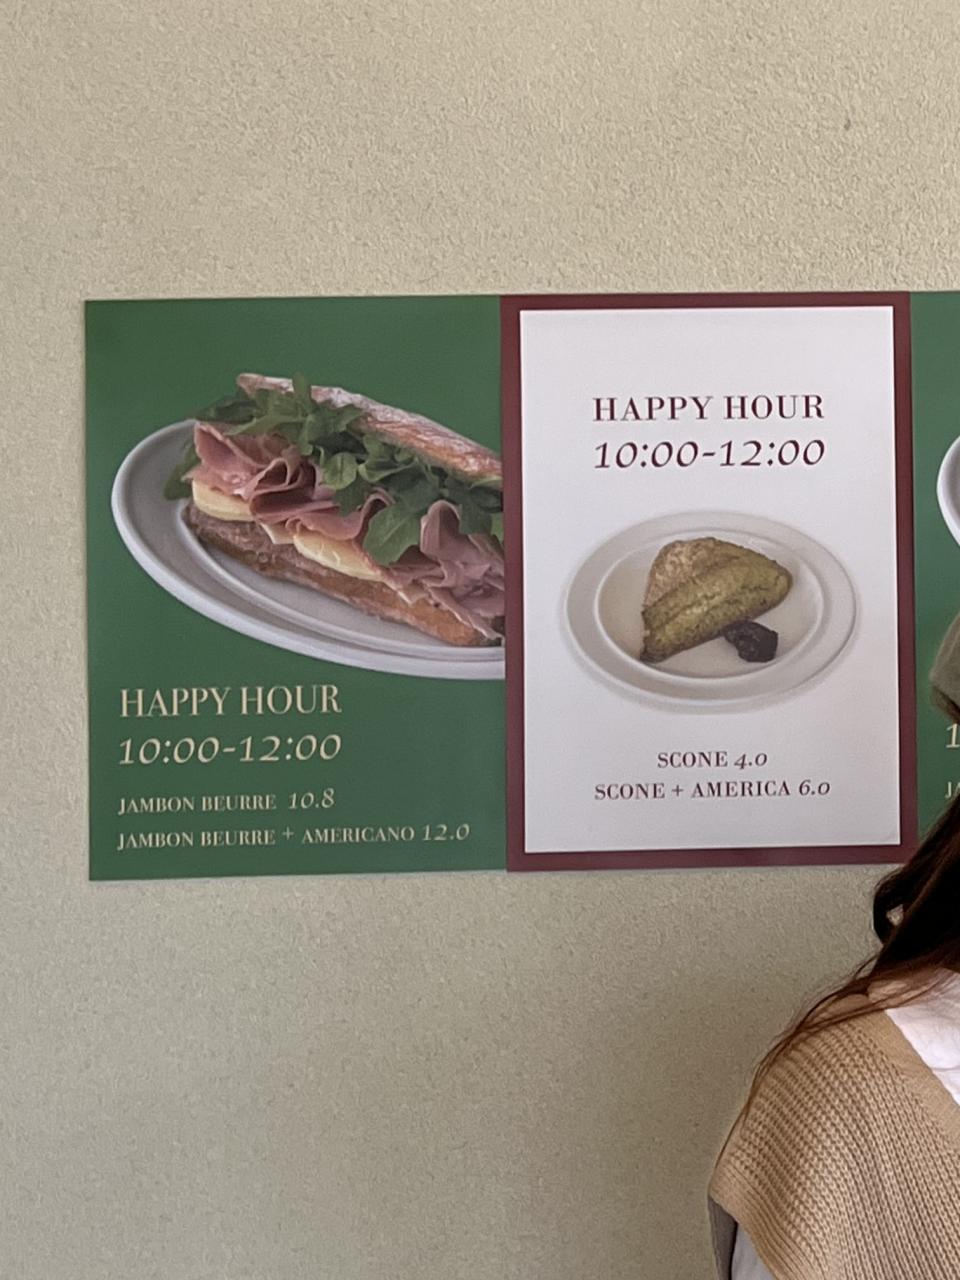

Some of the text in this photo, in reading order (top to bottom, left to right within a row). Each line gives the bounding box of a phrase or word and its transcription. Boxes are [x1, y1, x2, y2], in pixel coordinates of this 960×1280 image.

[593, 395, 825, 421] HAPPY HOUR
[596, 440, 824, 468] 10:00-12:00
[122, 685, 341, 716] HAPPY HOUR
[120, 735, 340, 763] 10:00-12:00
[658, 752, 767, 769] SCONE 4.0
[119, 789, 334, 814] JAMBON BEURRE 10.8
[596, 780, 830, 798] SCONE + AMERICA 6.0
[118, 824, 469, 850] JAMBON BEURRE + AMERICANO 12.0
